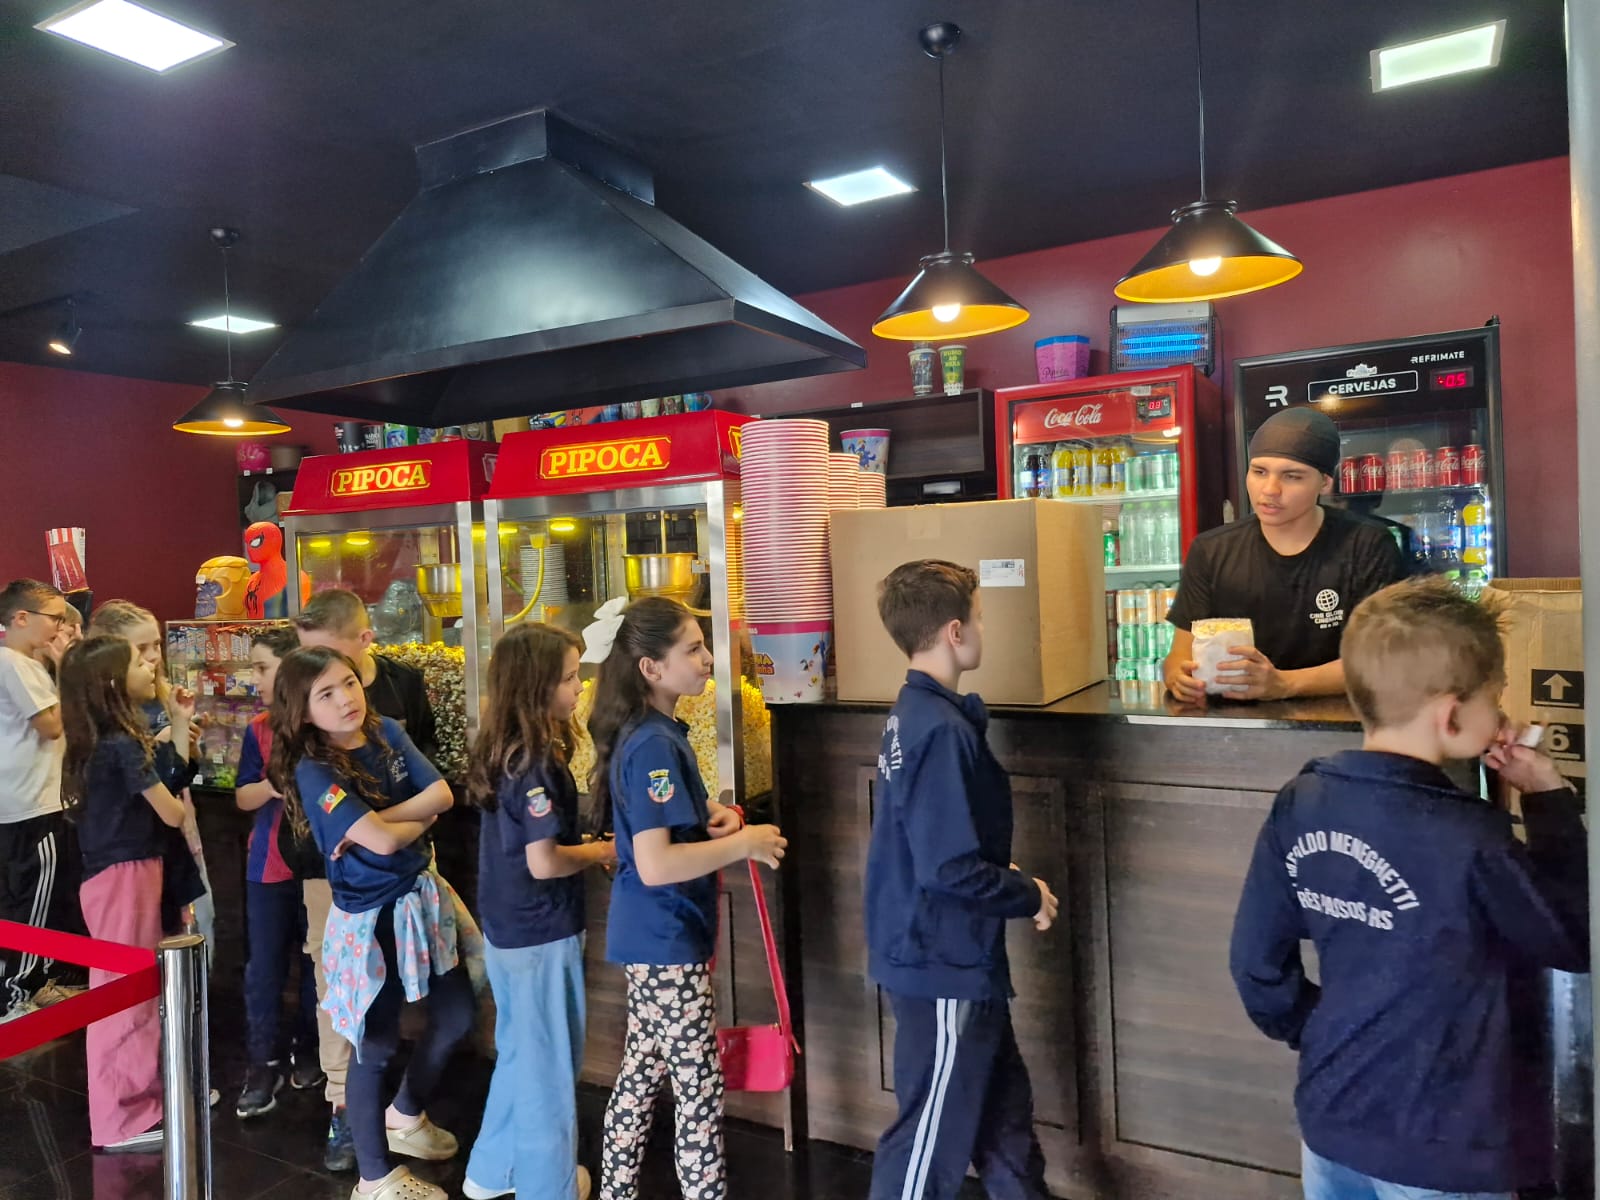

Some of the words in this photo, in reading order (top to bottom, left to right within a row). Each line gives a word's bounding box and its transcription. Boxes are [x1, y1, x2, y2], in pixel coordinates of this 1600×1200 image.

[1410, 350, 1465, 364] REFRIMATE
[1328, 378, 1397, 395] CERVEJAS
[548, 442, 662, 475] PIPOCA
[337, 464, 426, 493] PIPOCA
[1330, 831, 1420, 911] MENEGHETTI
[1368, 906, 1394, 930] RS
